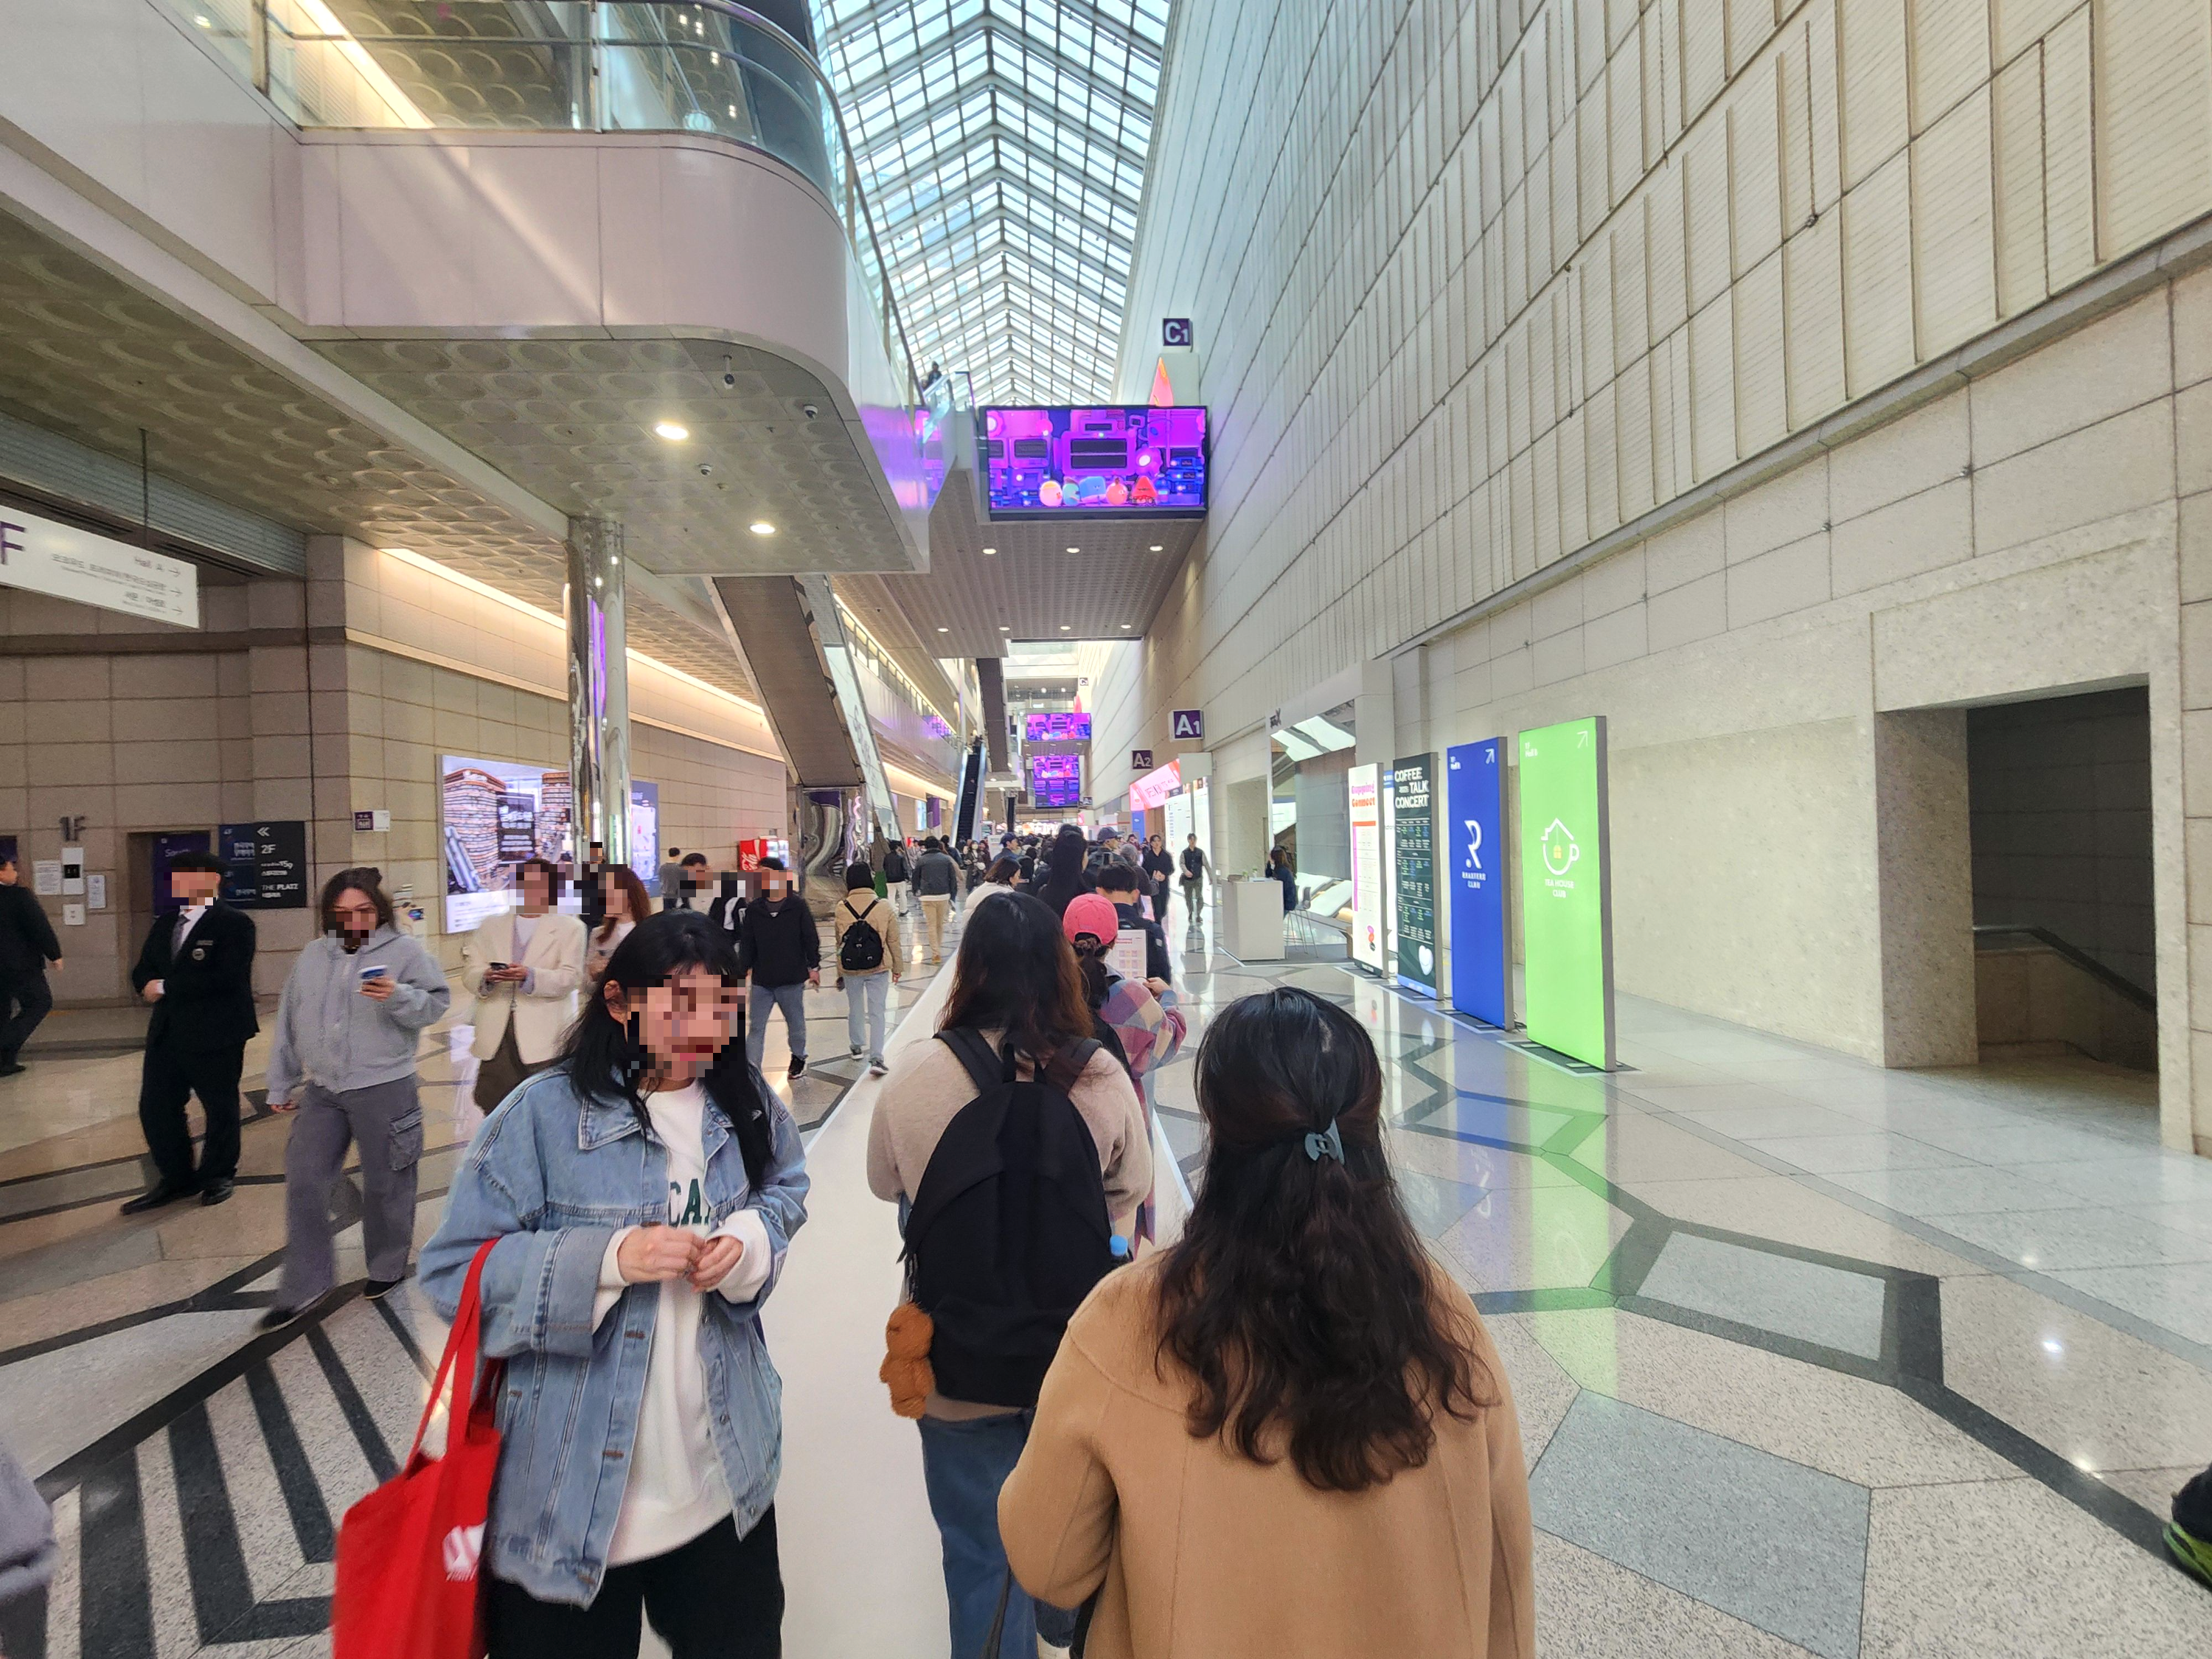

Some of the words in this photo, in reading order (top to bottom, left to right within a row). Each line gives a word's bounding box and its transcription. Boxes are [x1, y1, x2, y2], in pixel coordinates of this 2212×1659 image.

[1166, 321, 1189, 343] C1
[1176, 714, 1201, 735] A1
[1133, 752, 1151, 768] A2
[1394, 767, 1423, 782] COFFEE
[1409, 780, 1429, 793] TALK
[1395, 794, 1429, 809] CONCERT
[261, 844, 276, 854] 2F
[1544, 878, 1554, 887] TEA
[1554, 880, 1574, 889] HOUSE
[668, 1178, 709, 1228] CA
